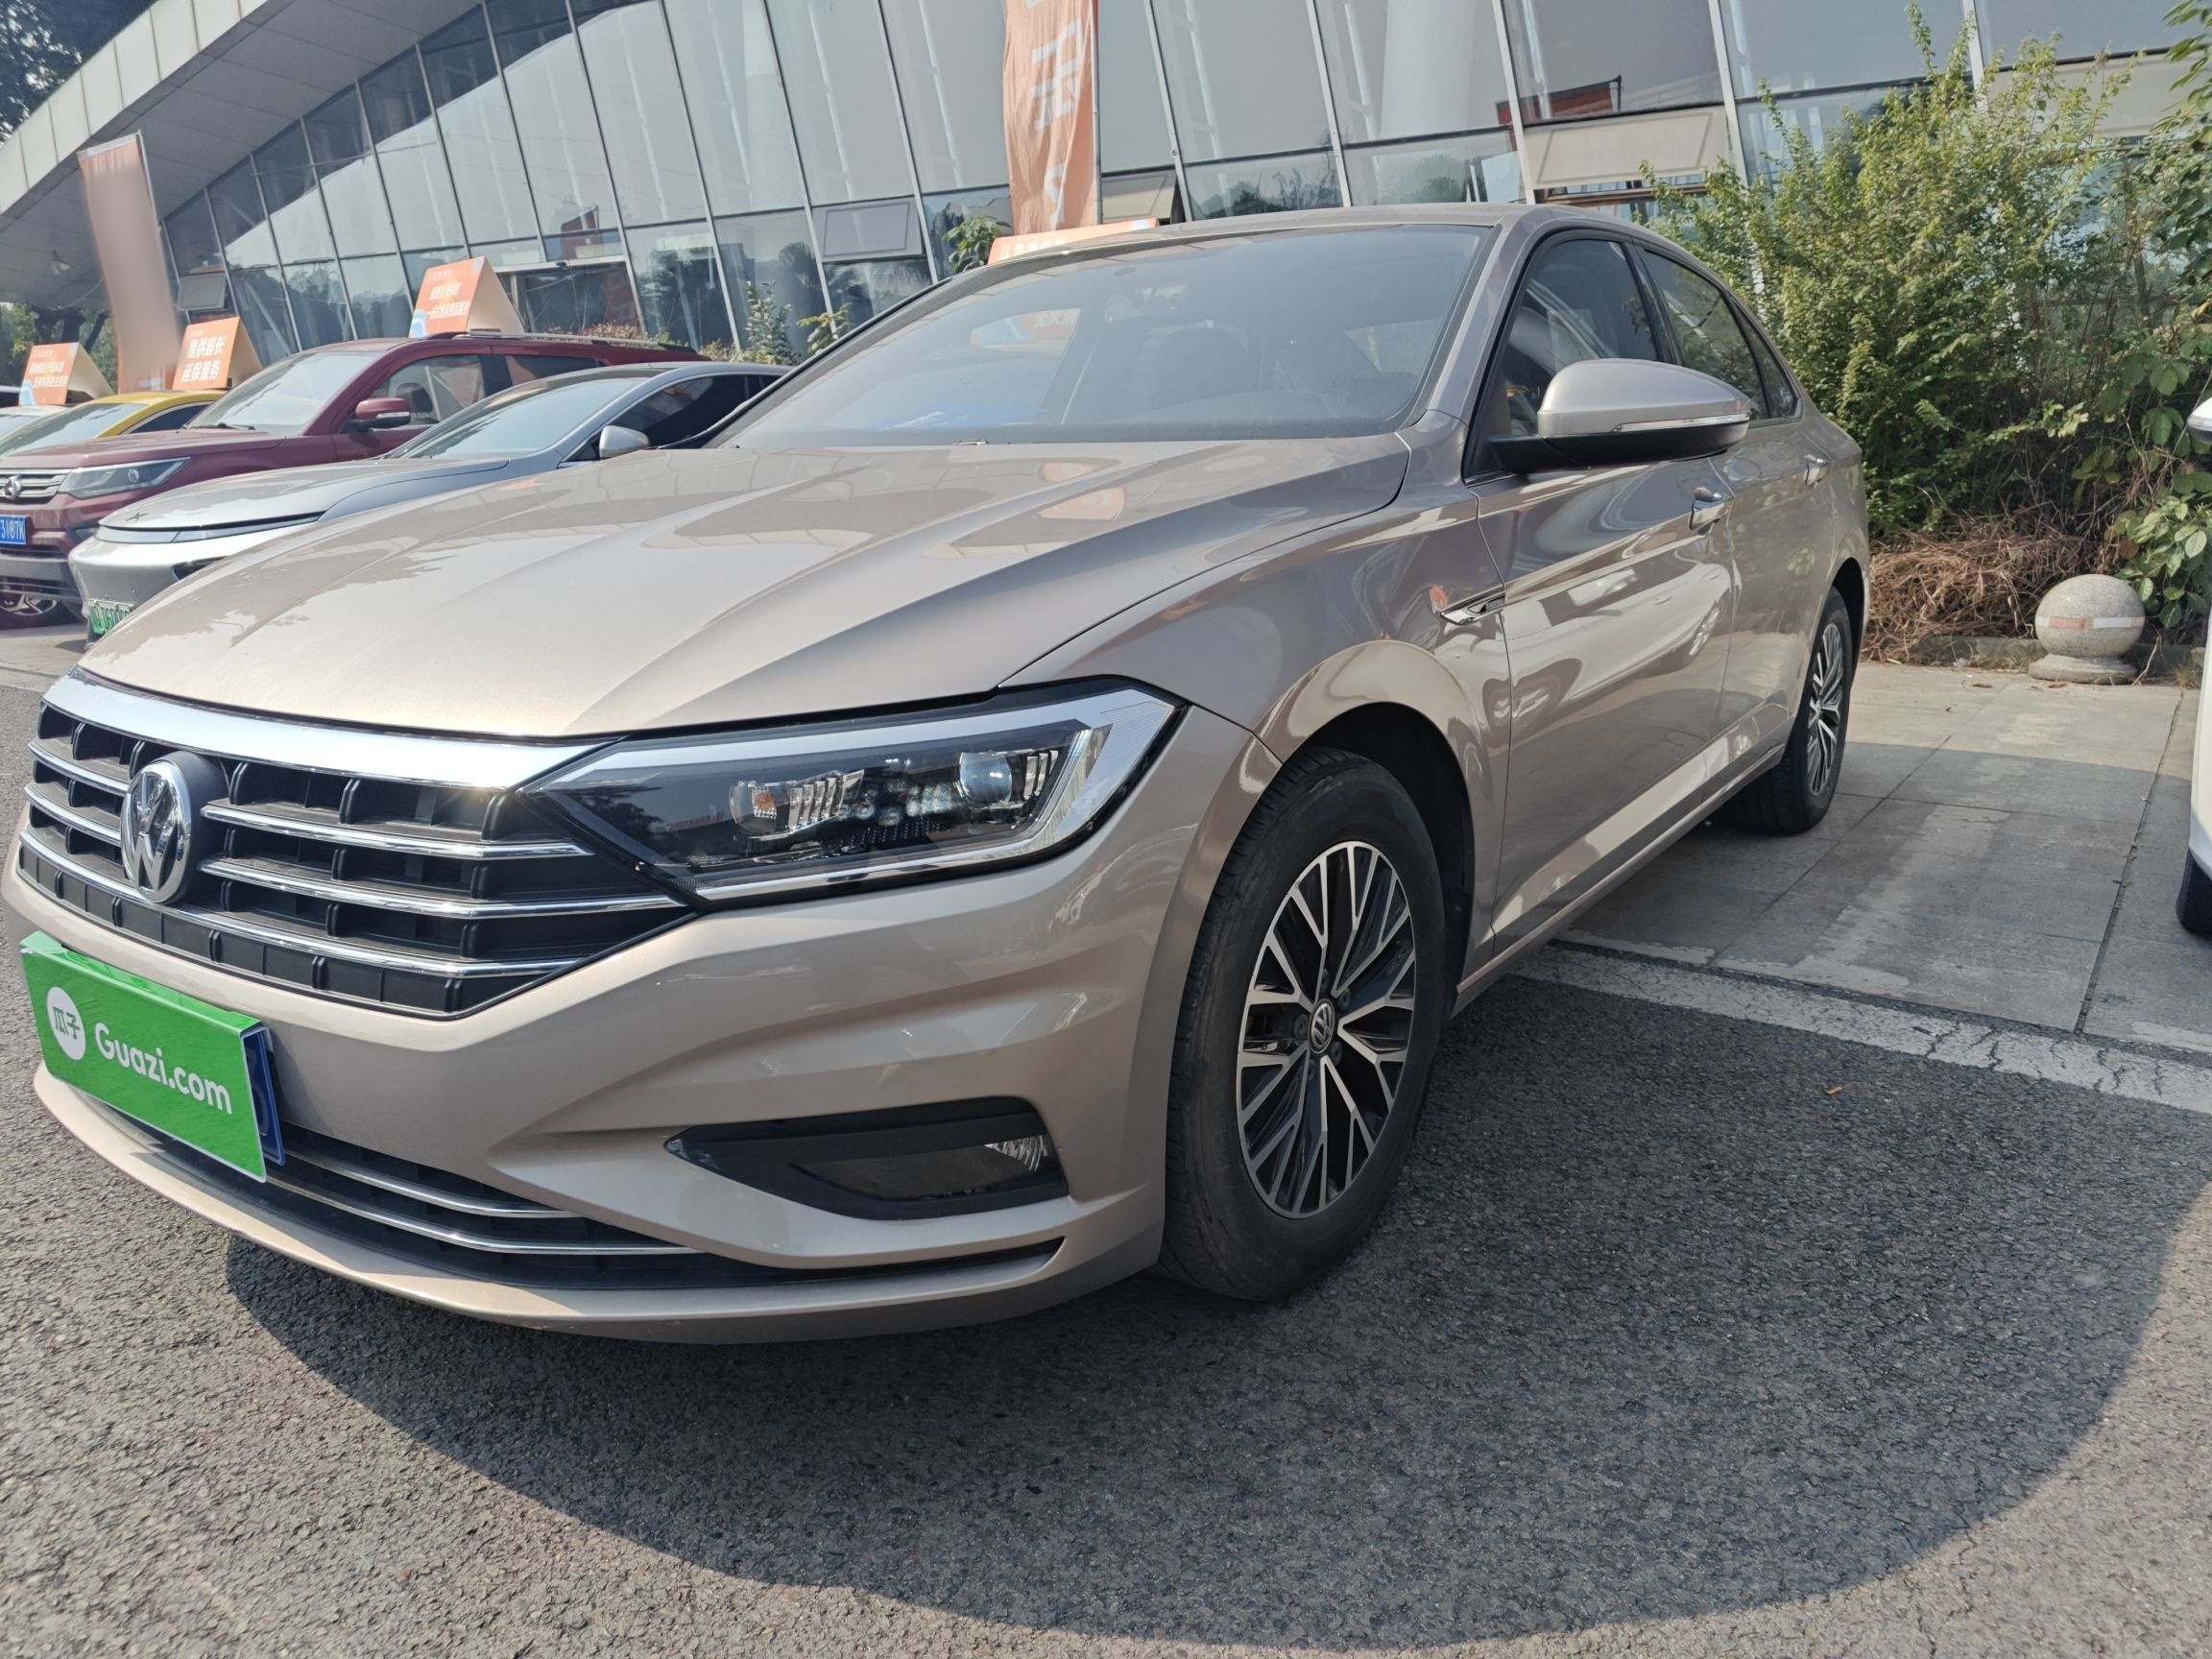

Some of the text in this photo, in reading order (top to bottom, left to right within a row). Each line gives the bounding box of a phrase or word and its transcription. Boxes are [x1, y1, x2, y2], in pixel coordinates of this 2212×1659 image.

[186, 334, 227, 360] 提供超长
[180, 359, 222, 383] 延保服务
[52, 1005, 81, 1040] 瓜子
[94, 1022, 233, 1116] Guazi.com
